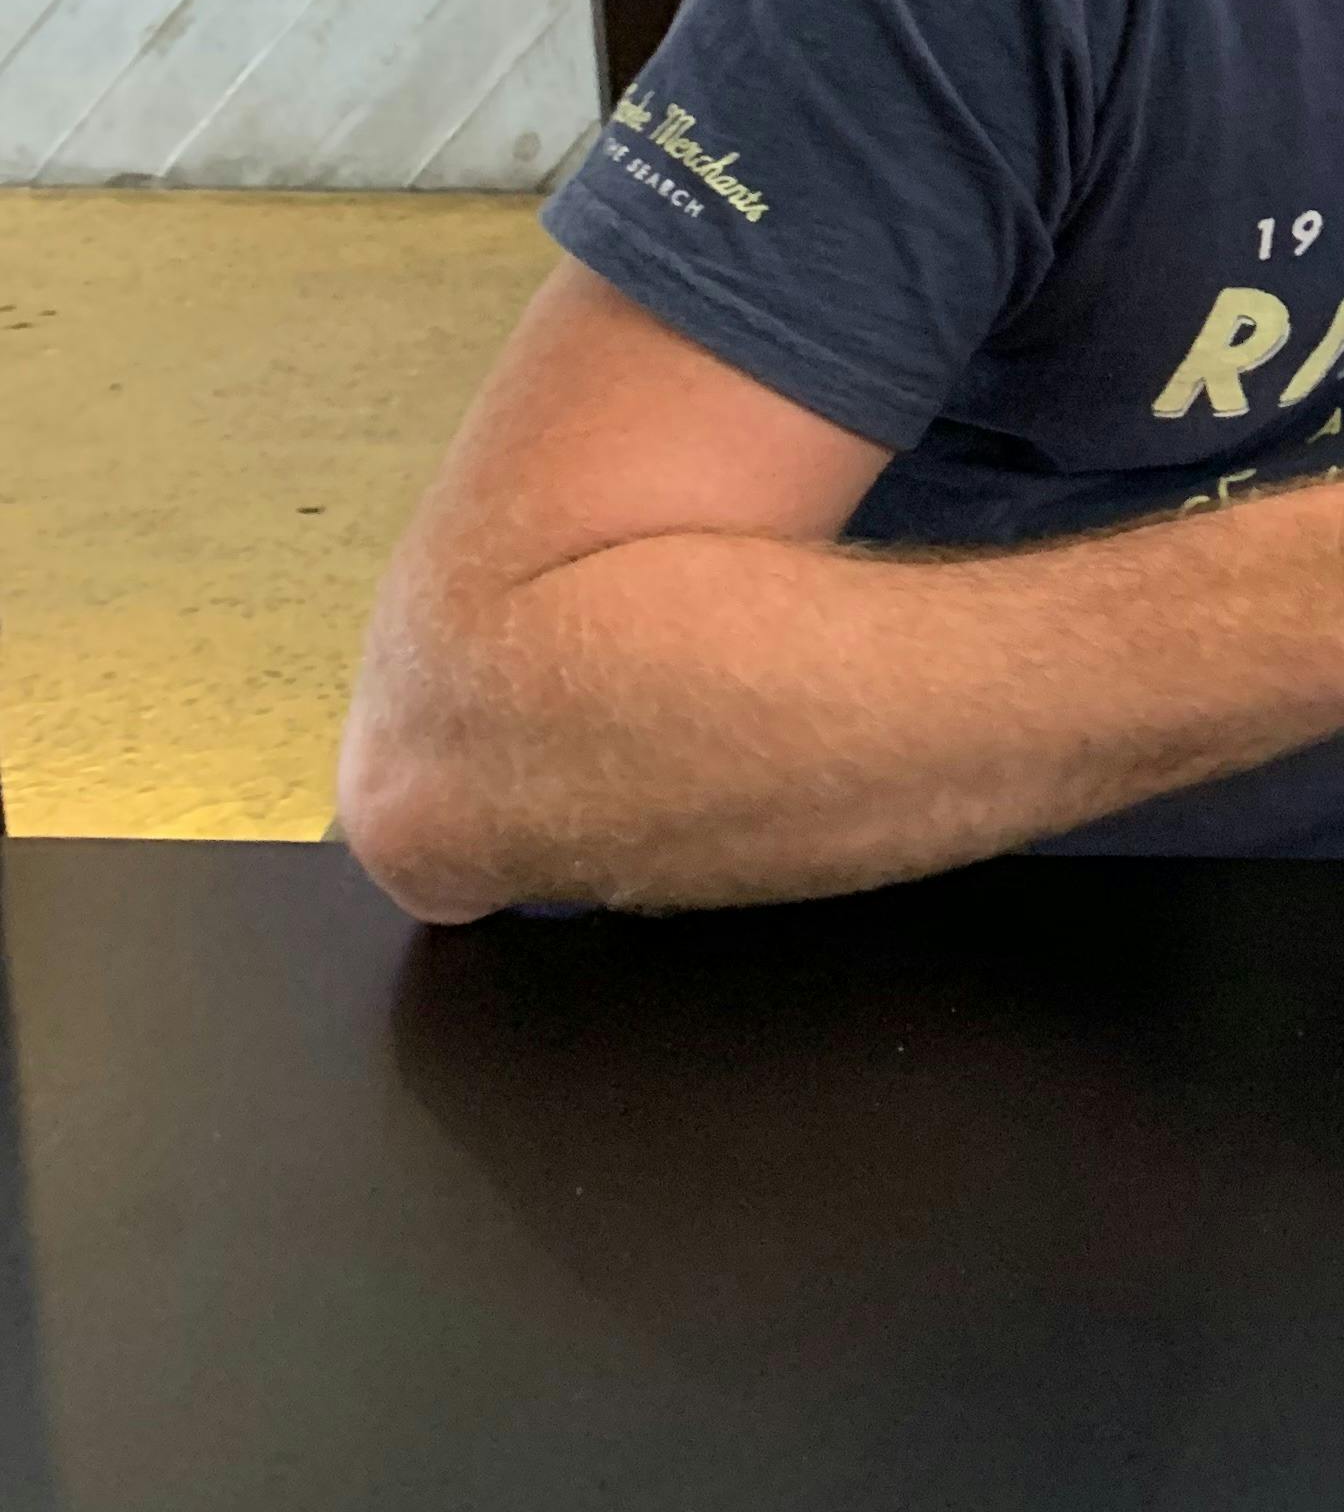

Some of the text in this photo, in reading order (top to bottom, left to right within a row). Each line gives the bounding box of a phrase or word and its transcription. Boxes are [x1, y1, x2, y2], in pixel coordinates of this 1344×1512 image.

[626, 157, 706, 219] SEARCH
[648, 102, 770, 223] Merchants
[1256, 207, 1327, 261] 19
